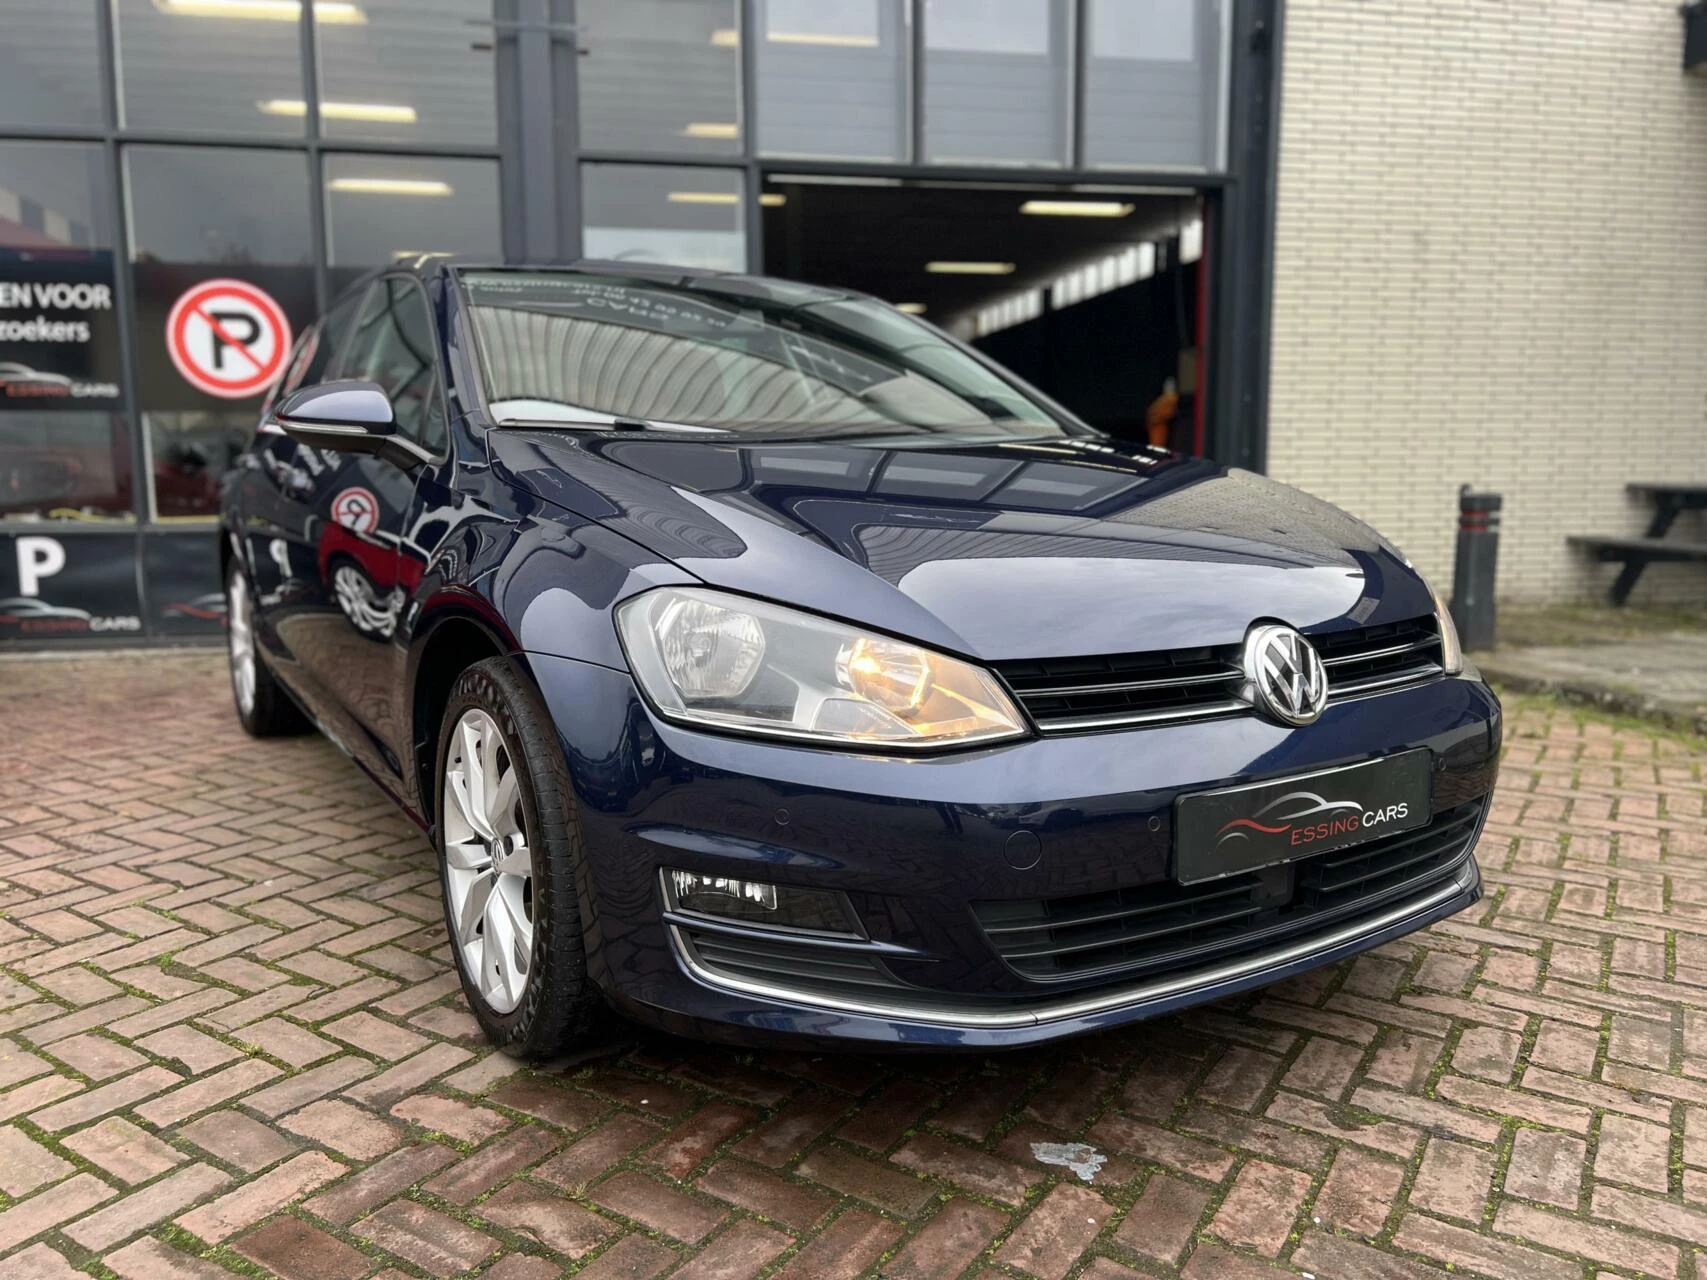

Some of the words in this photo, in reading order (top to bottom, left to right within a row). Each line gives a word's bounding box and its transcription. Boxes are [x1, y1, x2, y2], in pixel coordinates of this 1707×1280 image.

[0, 282, 33, 308] EN
[33, 283, 112, 310] VOOR
[15, 536, 66, 596] P
[89, 616, 141, 632] CARS
[1291, 815, 1360, 845] ESSING
[1362, 803, 1409, 828] CARS
